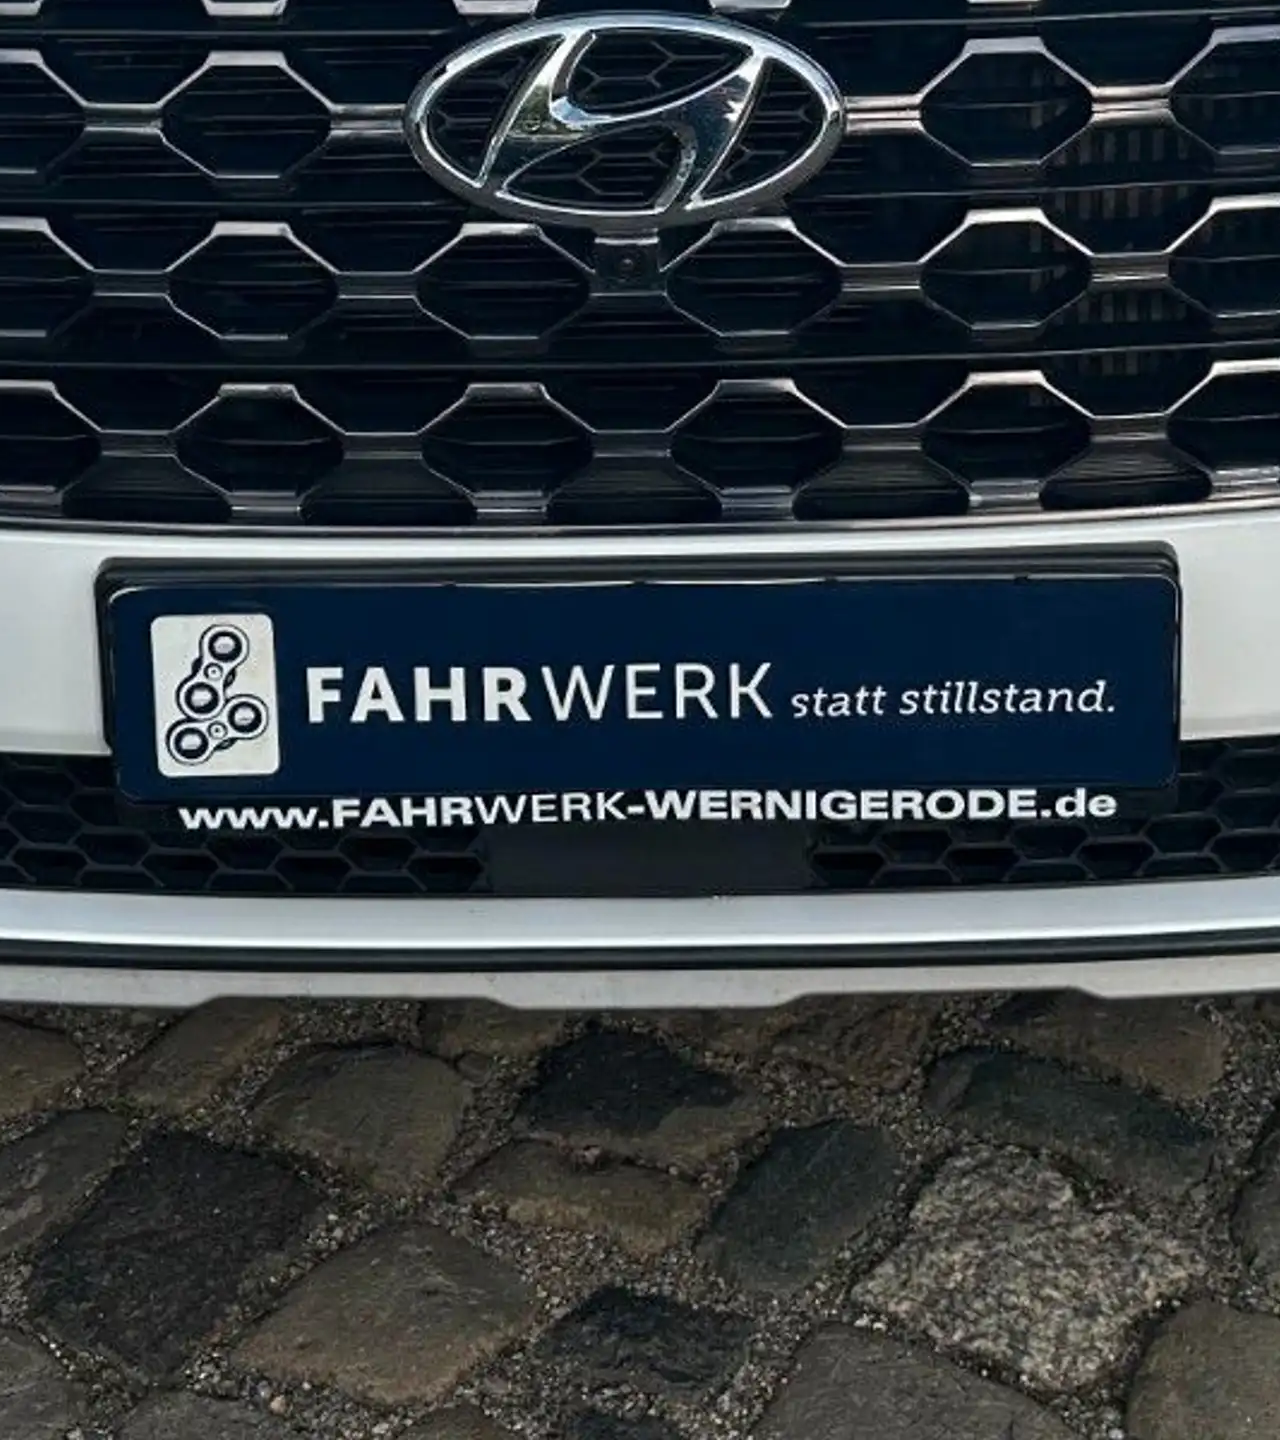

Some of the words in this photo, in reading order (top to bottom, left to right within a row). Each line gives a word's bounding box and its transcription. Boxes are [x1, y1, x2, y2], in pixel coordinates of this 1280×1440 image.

[306, 662, 773, 724] FAHRWERK
[791, 685, 886, 718] statt
[898, 679, 1116, 715] stillstand.
[178, 787, 1117, 830] www.FAHRWERK-WERNIGERODE.de
